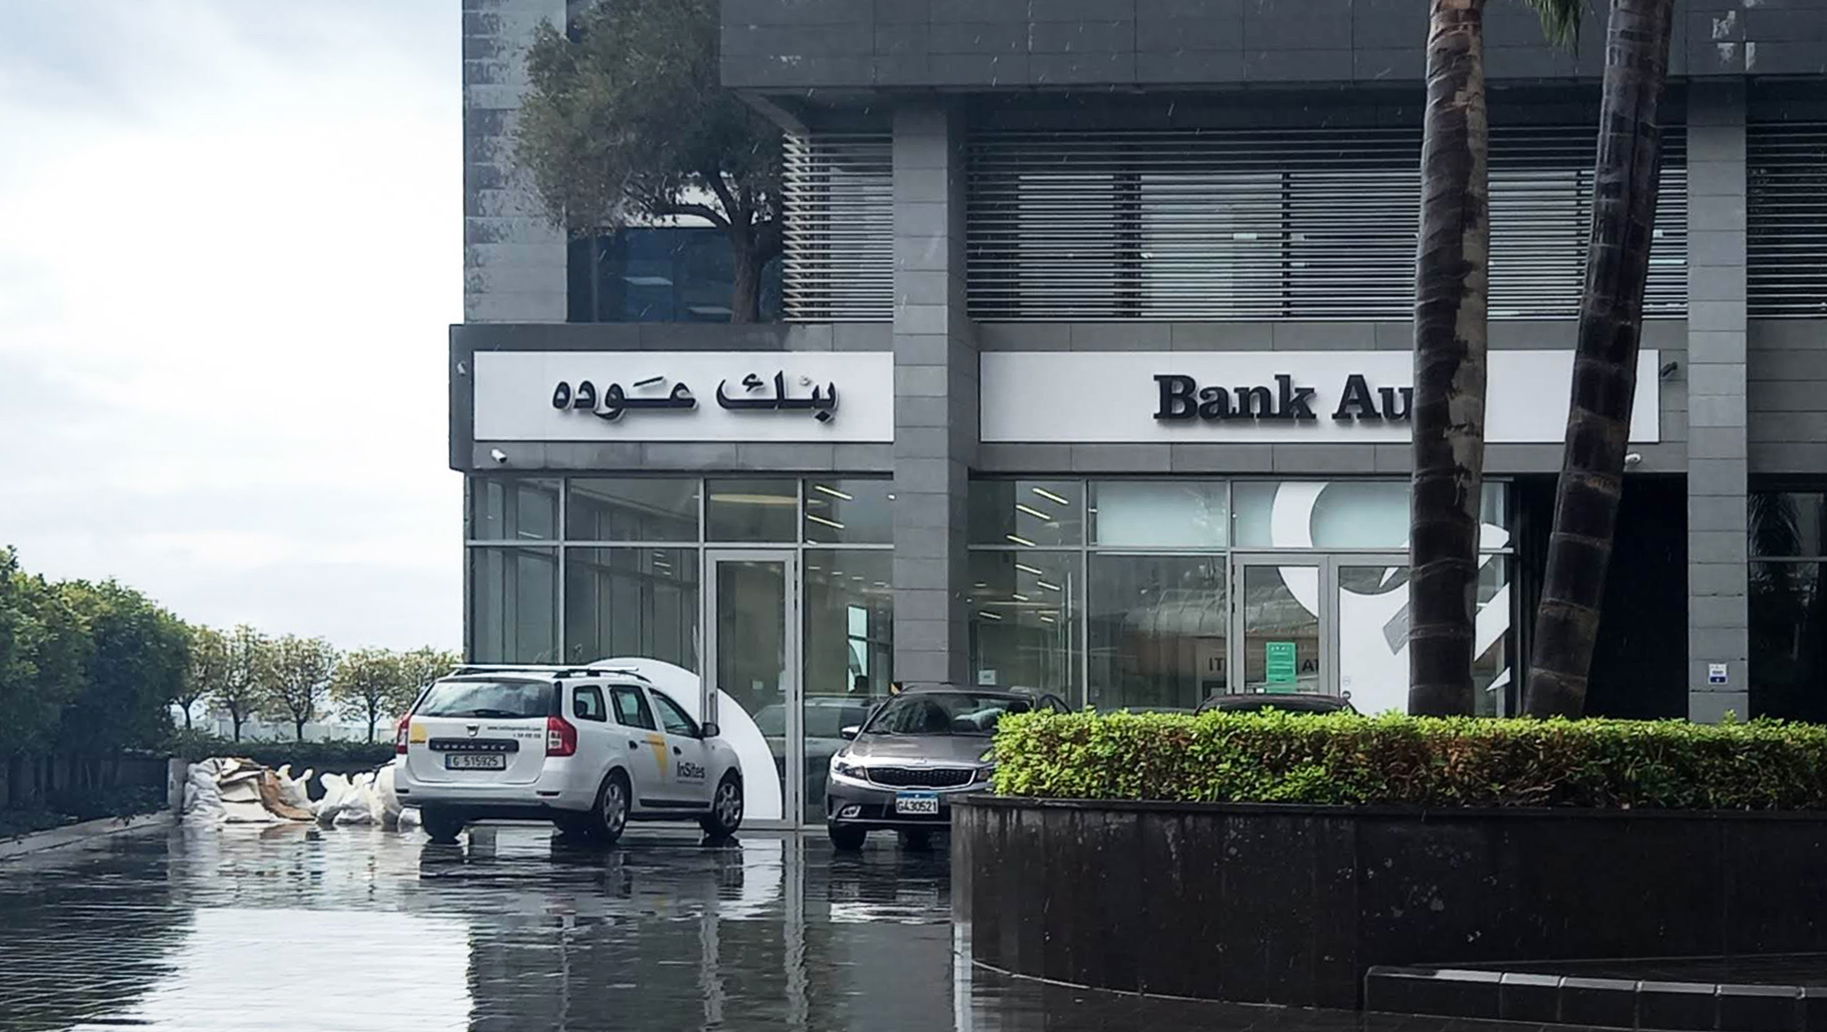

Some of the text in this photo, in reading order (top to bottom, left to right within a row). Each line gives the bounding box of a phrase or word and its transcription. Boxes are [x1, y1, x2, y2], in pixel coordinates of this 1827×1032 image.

[716, 370, 838, 423] بنك
[1153, 374, 1414, 420] Bank Au
[677, 761, 705, 779] InSites
